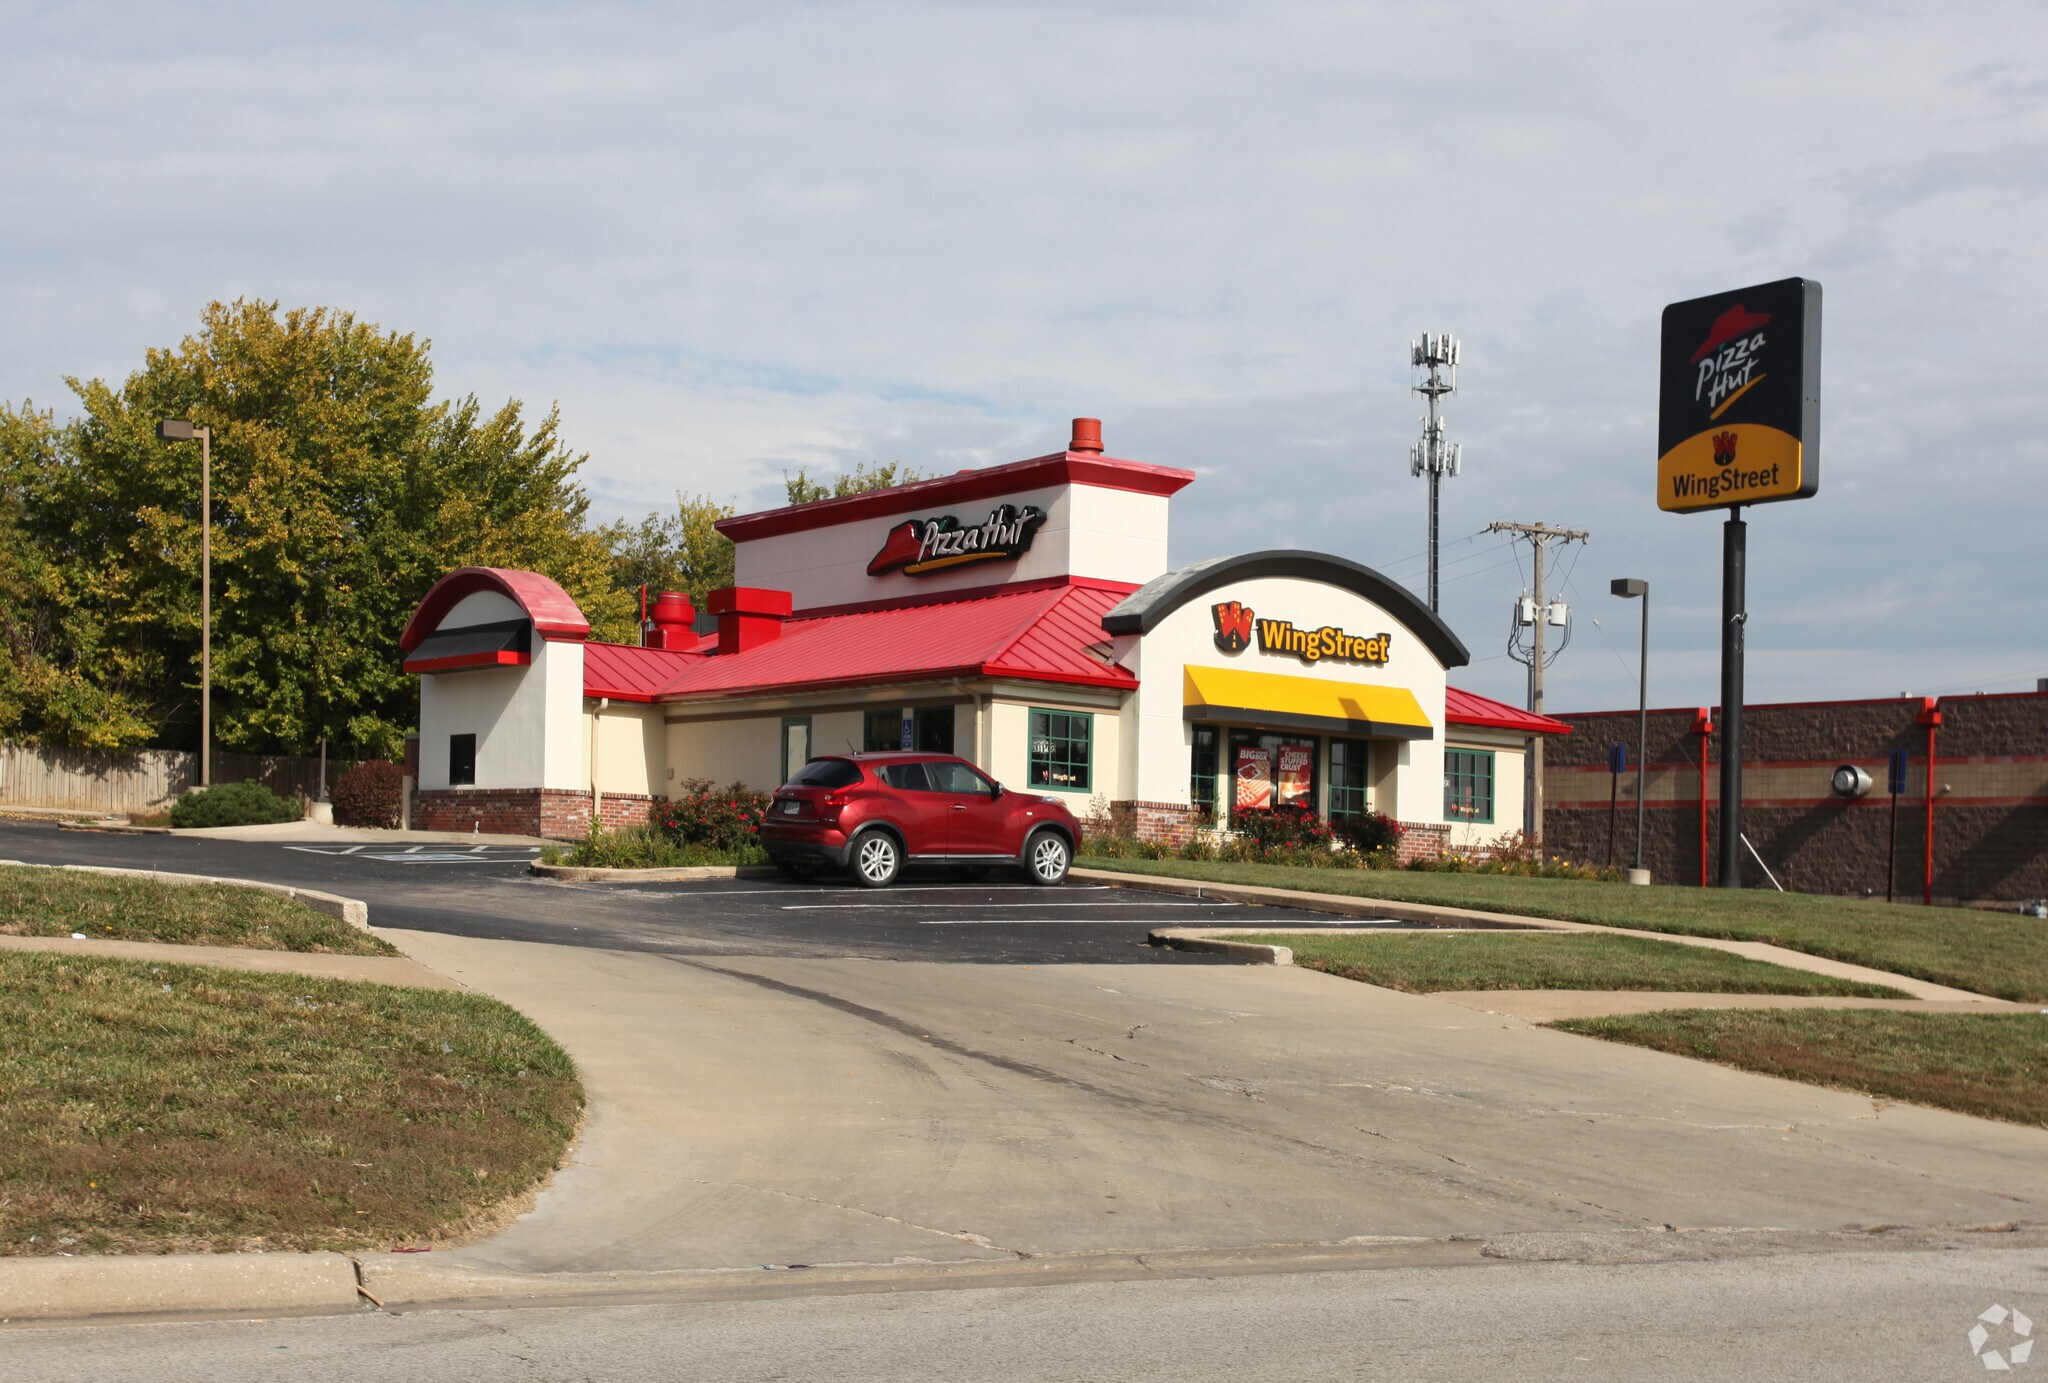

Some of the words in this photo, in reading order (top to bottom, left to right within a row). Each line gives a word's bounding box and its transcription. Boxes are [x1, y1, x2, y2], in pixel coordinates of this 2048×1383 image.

[1695, 332, 1766, 402] Pizza
[1708, 358, 1760, 408] Hut
[1672, 463, 1780, 498] WingStreet
[917, 519, 978, 562] Pizza
[980, 508, 1036, 549] Hut
[1261, 619, 1389, 663] WingStreet
[1240, 750, 1255, 759] BIG
[1280, 757, 1308, 765] STUFFED
